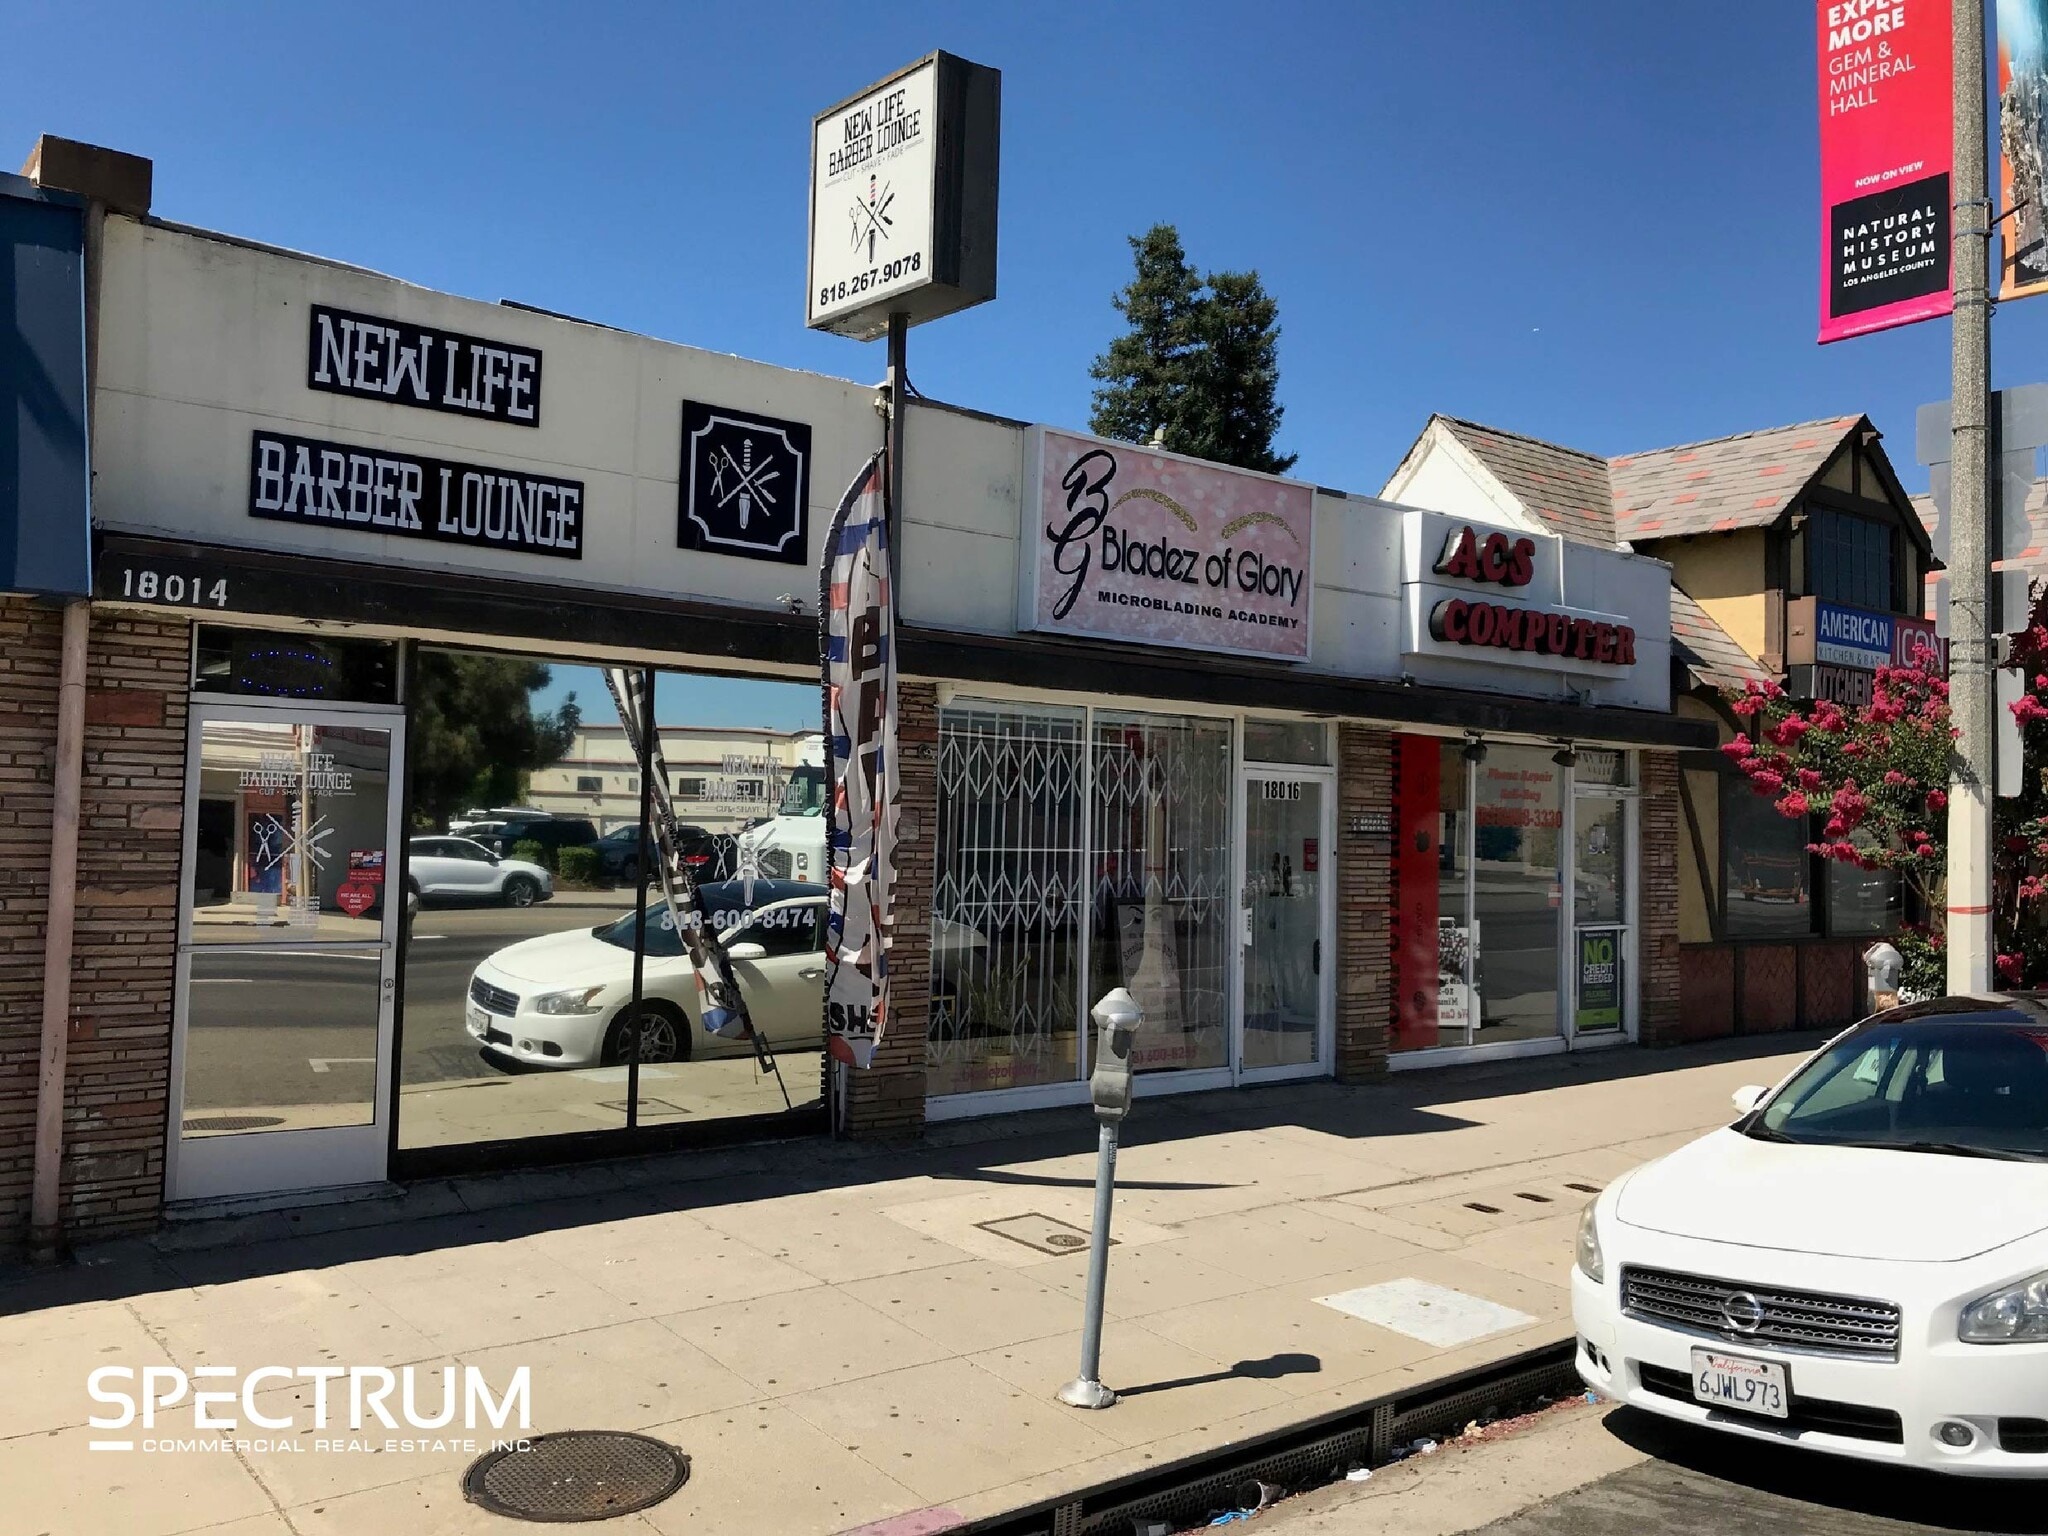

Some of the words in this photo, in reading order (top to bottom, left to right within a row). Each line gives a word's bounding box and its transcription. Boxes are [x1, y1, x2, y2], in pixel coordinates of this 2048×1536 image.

[1828, 0, 1904, 28] EXPL
[1828, 6, 1905, 52] MORE
[1829, 45, 1872, 76] GEM
[1877, 40, 1893, 60] &
[1829, 54, 1916, 97] MINERAL
[843, 105, 872, 144] NEW
[877, 88, 906, 126] LIFE
[1830, 87, 1878, 117] HALL
[828, 134, 874, 177] BARBER
[876, 109, 921, 154] LOUNGE
[1854, 174, 1880, 188] NOW
[1882, 170, 1898, 182] ON
[1898, 160, 1924, 177] VIEW
[1843, 205, 1936, 241] NATURAL
[1843, 222, 1936, 258] HISTORY
[1843, 240, 1936, 275] MUSEUM
[1843, 277, 1859, 287] LOS
[1860, 266, 1899, 284] ANGELES
[1899, 258, 1936, 275] COUNTY
[820, 252, 921, 306] 818.267.9078
[314, 314, 433, 400] NEW
[443, 340, 537, 420] LIFE
[255, 440, 423, 530] BARBER
[438, 468, 580, 549] LOUNGE
[1102, 525, 1199, 585] Bladez
[1205, 547, 1232, 588] of
[1237, 550, 1304, 607] Glory
[1444, 526, 1536, 587] ACS
[122, 569, 228, 607] 18014
[1098, 591, 1223, 619] MICROBLADING
[1228, 609, 1299, 630] ACADEMY
[1820, 609, 1889, 647] AMERICAN
[1442, 598, 1637, 665] COMPUTER
[1818, 645, 1855, 664] KITCHEN
[239, 770, 297, 787] BARBER
[258, 788, 275, 796] CUT
[313, 790, 334, 798] FADE
[1264, 781, 1301, 799] 18016
[660, 907, 816, 931] 818-600-8474
[1584, 939, 1613, 964] NO
[1584, 963, 1614, 975] CREDIT
[1584, 973, 1614, 984] NEEDED
[1710, 1356, 1761, 1375] California
[1699, 1370, 1780, 1409] 6JWL973
